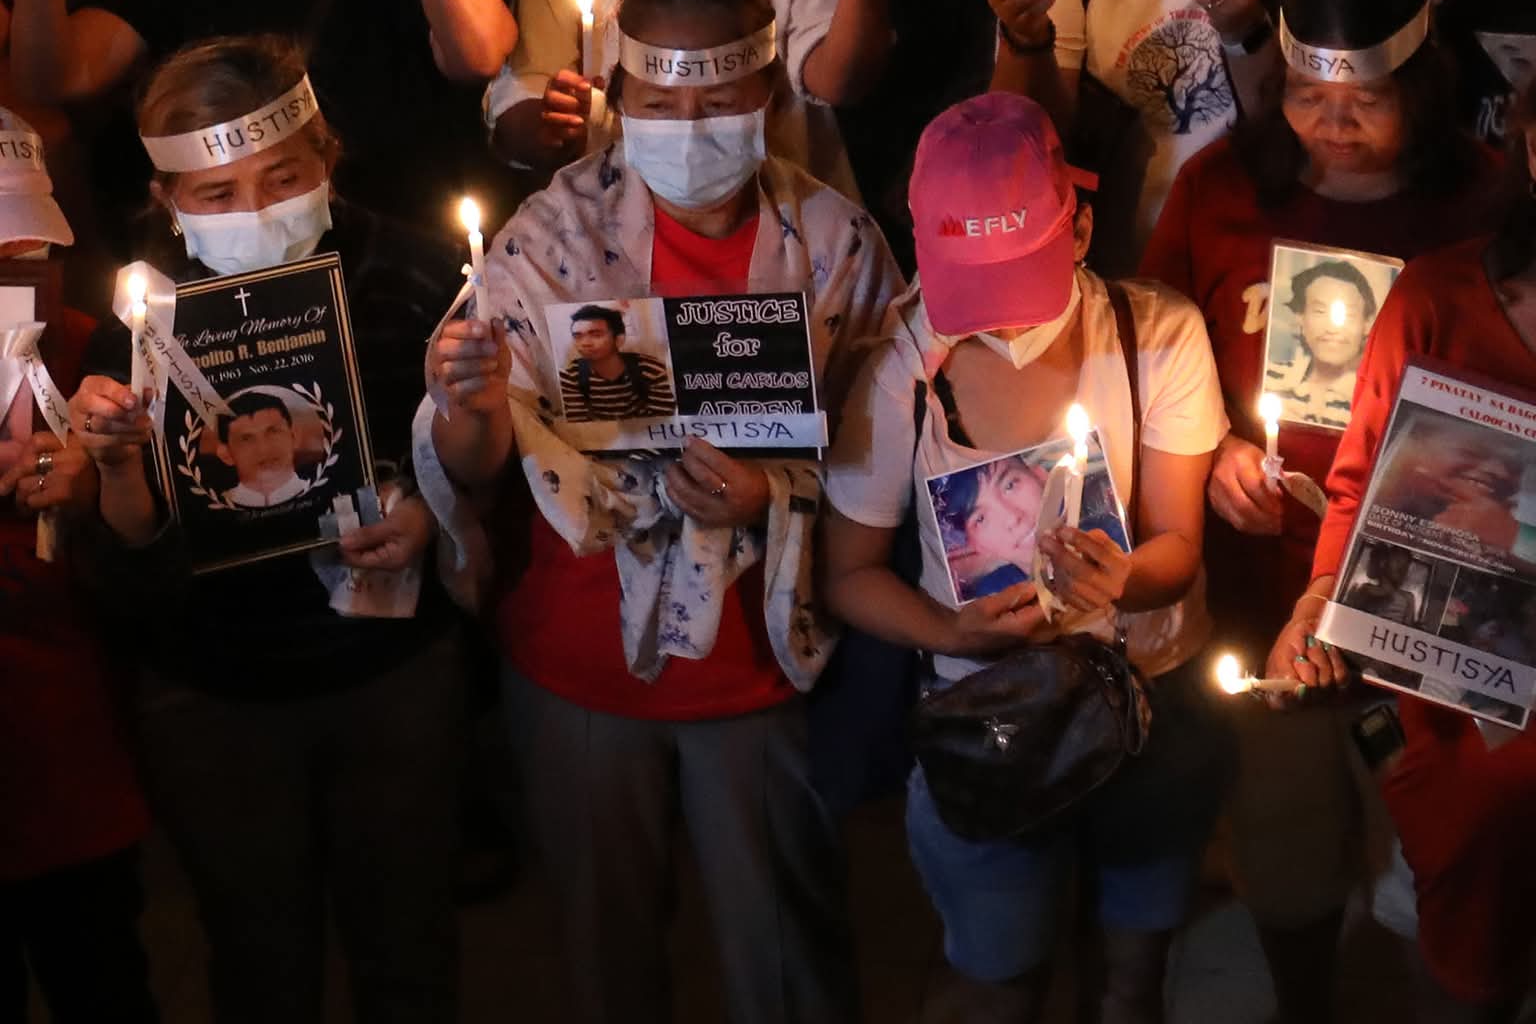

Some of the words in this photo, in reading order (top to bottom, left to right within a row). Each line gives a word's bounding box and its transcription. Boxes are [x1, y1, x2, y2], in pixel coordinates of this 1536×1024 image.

[644, 46, 760, 77] HUSTISYA
[240, 314, 302, 336] Memory
[303, 304, 328, 323] Of
[676, 299, 801, 326] JUSTICE
[237, 343, 254, 361] R.
[255, 328, 328, 357] Benjamin
[712, 331, 761, 358] for
[683, 372, 723, 390] IAN
[726, 371, 810, 390] CARLOS
[1429, 378, 1483, 404] PINATAY
[1489, 394, 1506, 410] SA
[648, 421, 794, 441] HUSTISYA
[1459, 406, 1522, 435] CALOOCAN
[1372, 504, 1418, 523] SONNY
[1367, 519, 1415, 540] BIRTHDAY
[1369, 625, 1516, 694] HUSTISYA
